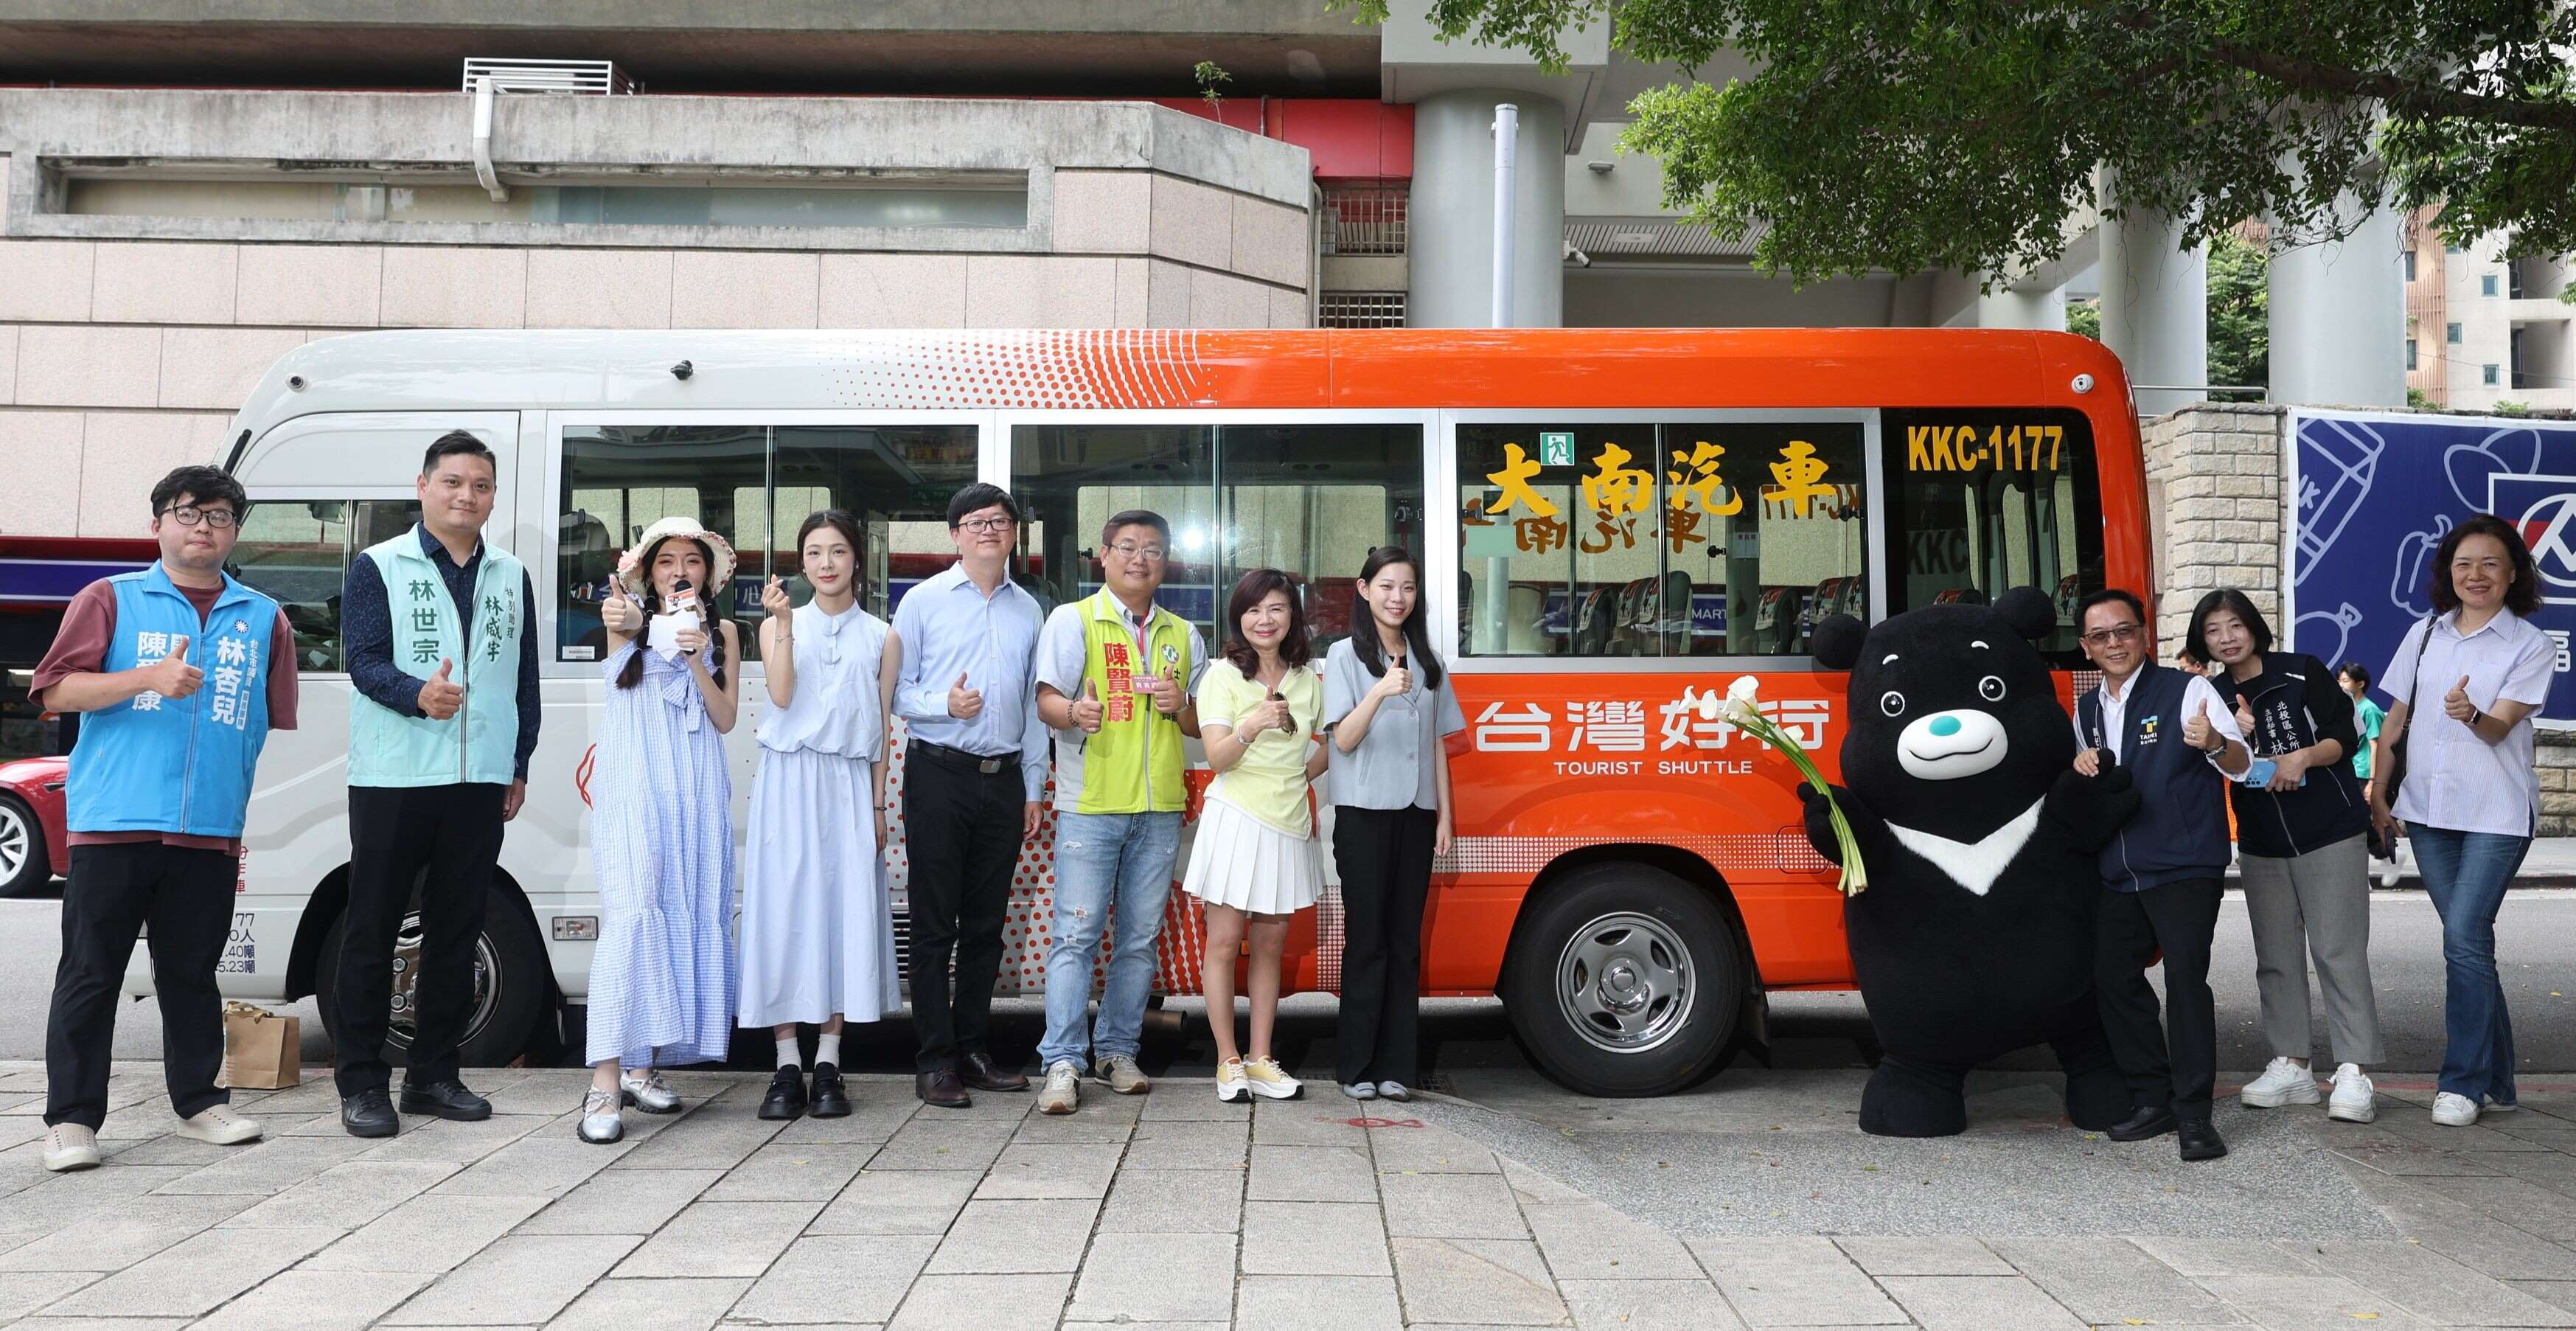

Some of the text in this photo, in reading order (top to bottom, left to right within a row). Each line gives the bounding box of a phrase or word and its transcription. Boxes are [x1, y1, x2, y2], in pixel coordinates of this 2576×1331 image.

[1485, 440, 1839, 516] 大南汽車
[1907, 425, 2063, 472] KKC-1177
[408, 579, 440, 664] 林世宗
[484, 595, 504, 663] 林威宇
[505, 587, 516, 639] 特別助理
[131, 631, 168, 711] 陳康
[211, 636, 246, 725] 林杏兒
[1104, 642, 1134, 723] 陳賢蔚
[2277, 701, 2300, 751] 北投區公所
[1553, 760, 1752, 776] TOURIST SHUTTLE
